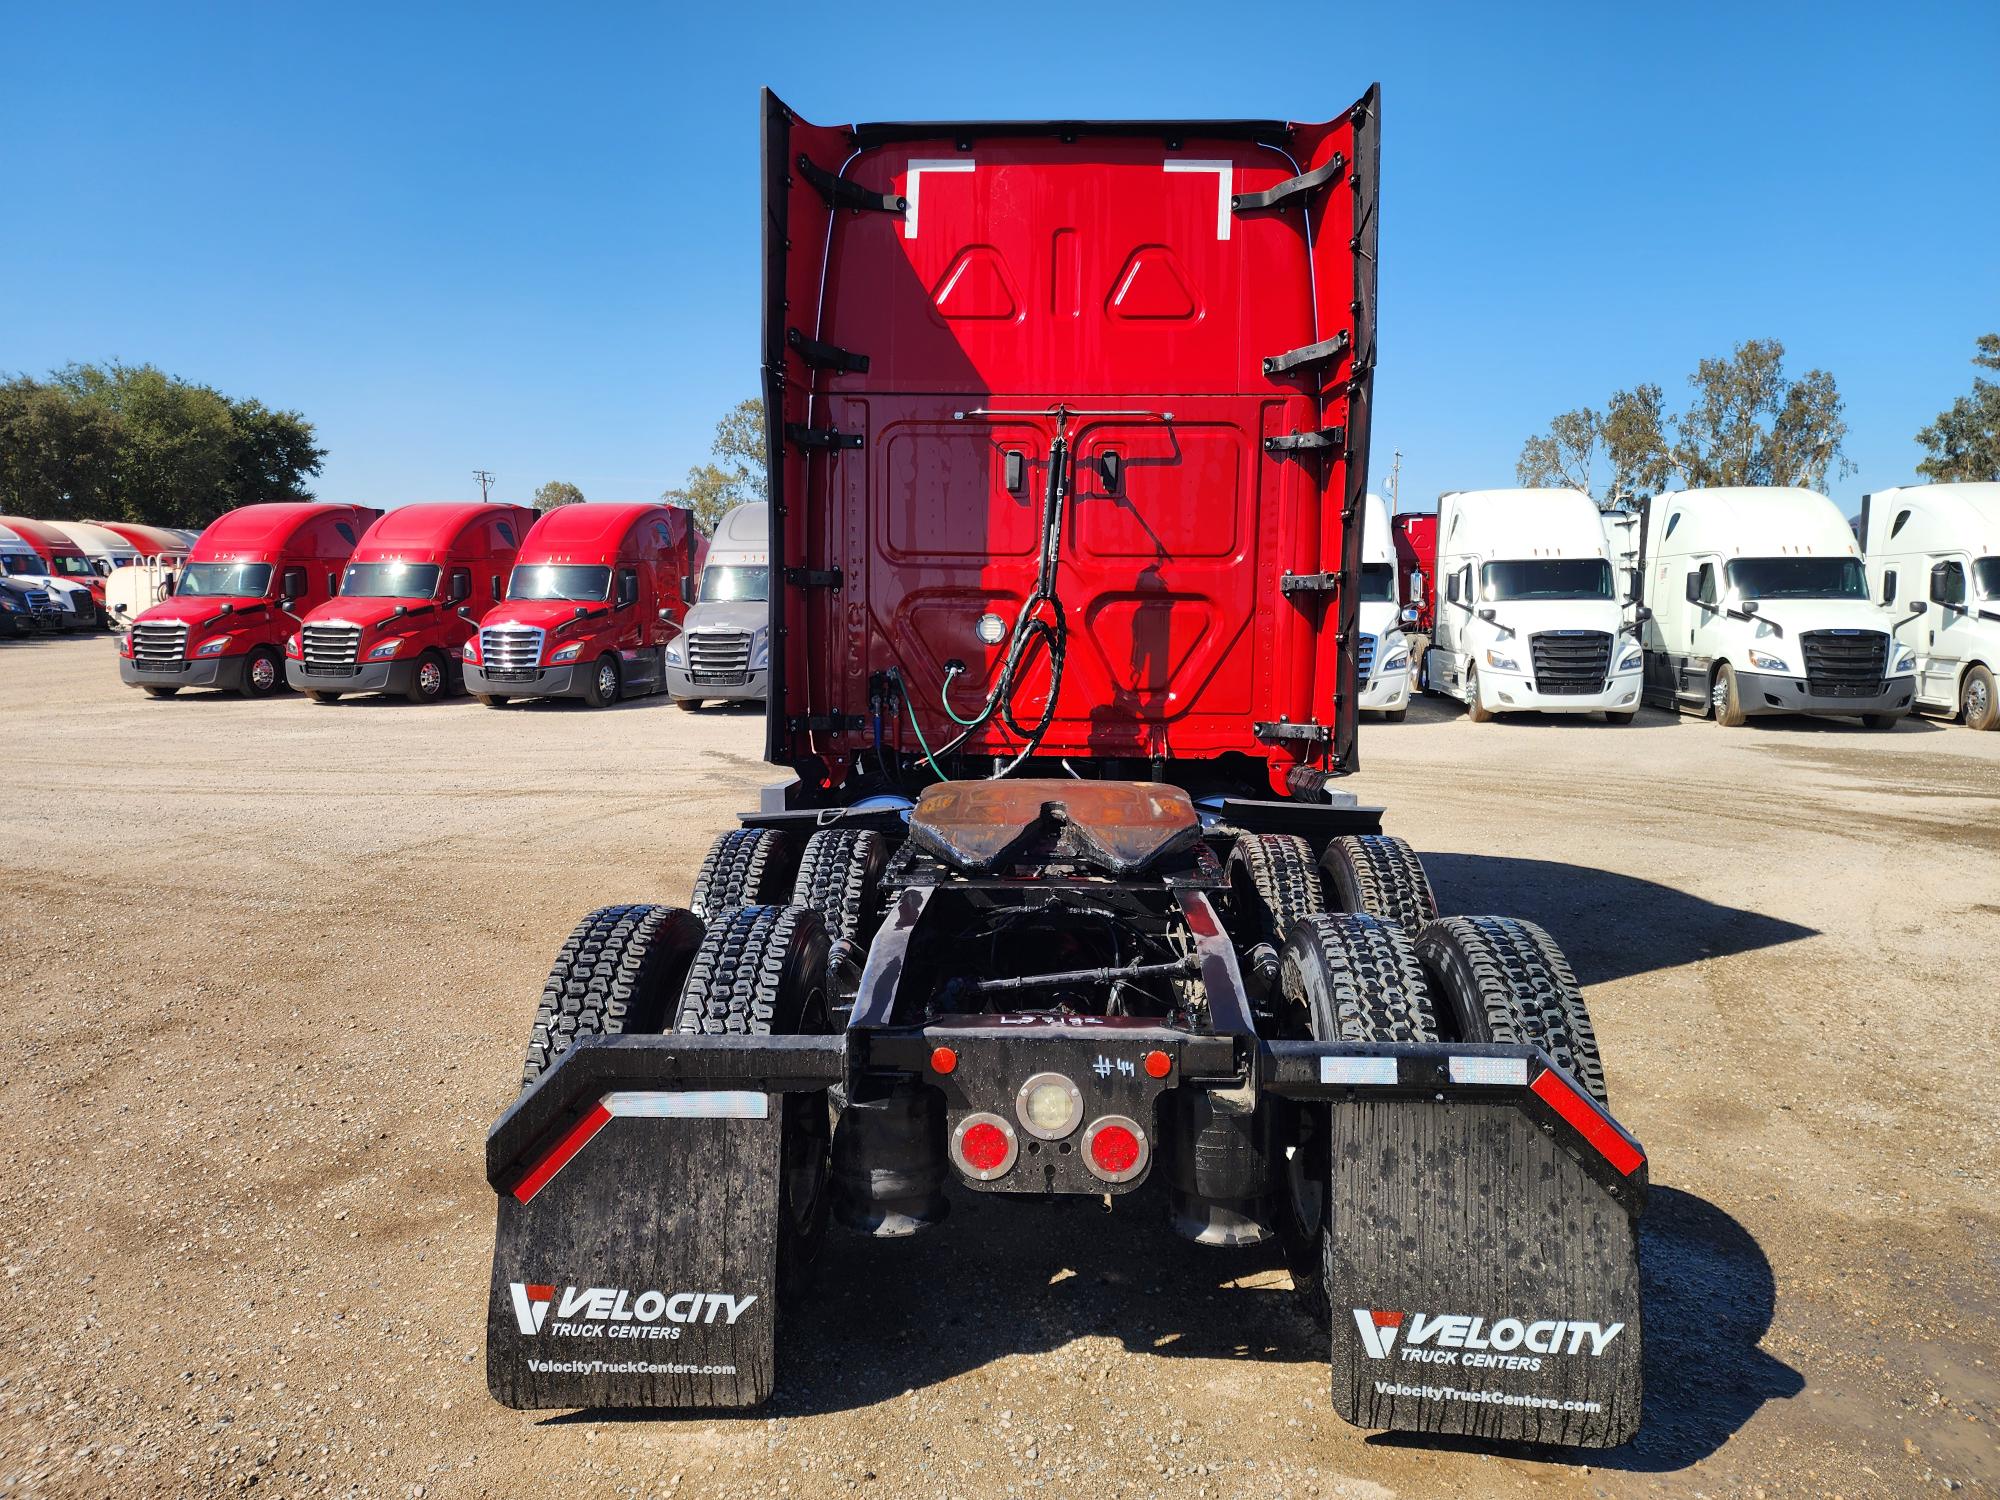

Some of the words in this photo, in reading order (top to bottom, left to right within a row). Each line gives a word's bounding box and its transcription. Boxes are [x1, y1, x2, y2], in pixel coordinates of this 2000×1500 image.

[557, 1286, 758, 1325] VELOCITY
[551, 1322, 603, 1338] TRUCK
[608, 1324, 681, 1340] CENTERS
[1406, 1313, 1626, 1356] VELOCITY
[527, 1359, 736, 1375] VelocityTruckCenters.com
[1401, 1347, 1457, 1365] TRUCK
[1461, 1354, 1542, 1372] CENTERS
[1375, 1381, 1601, 1413] VelocityTruckCenters.com
